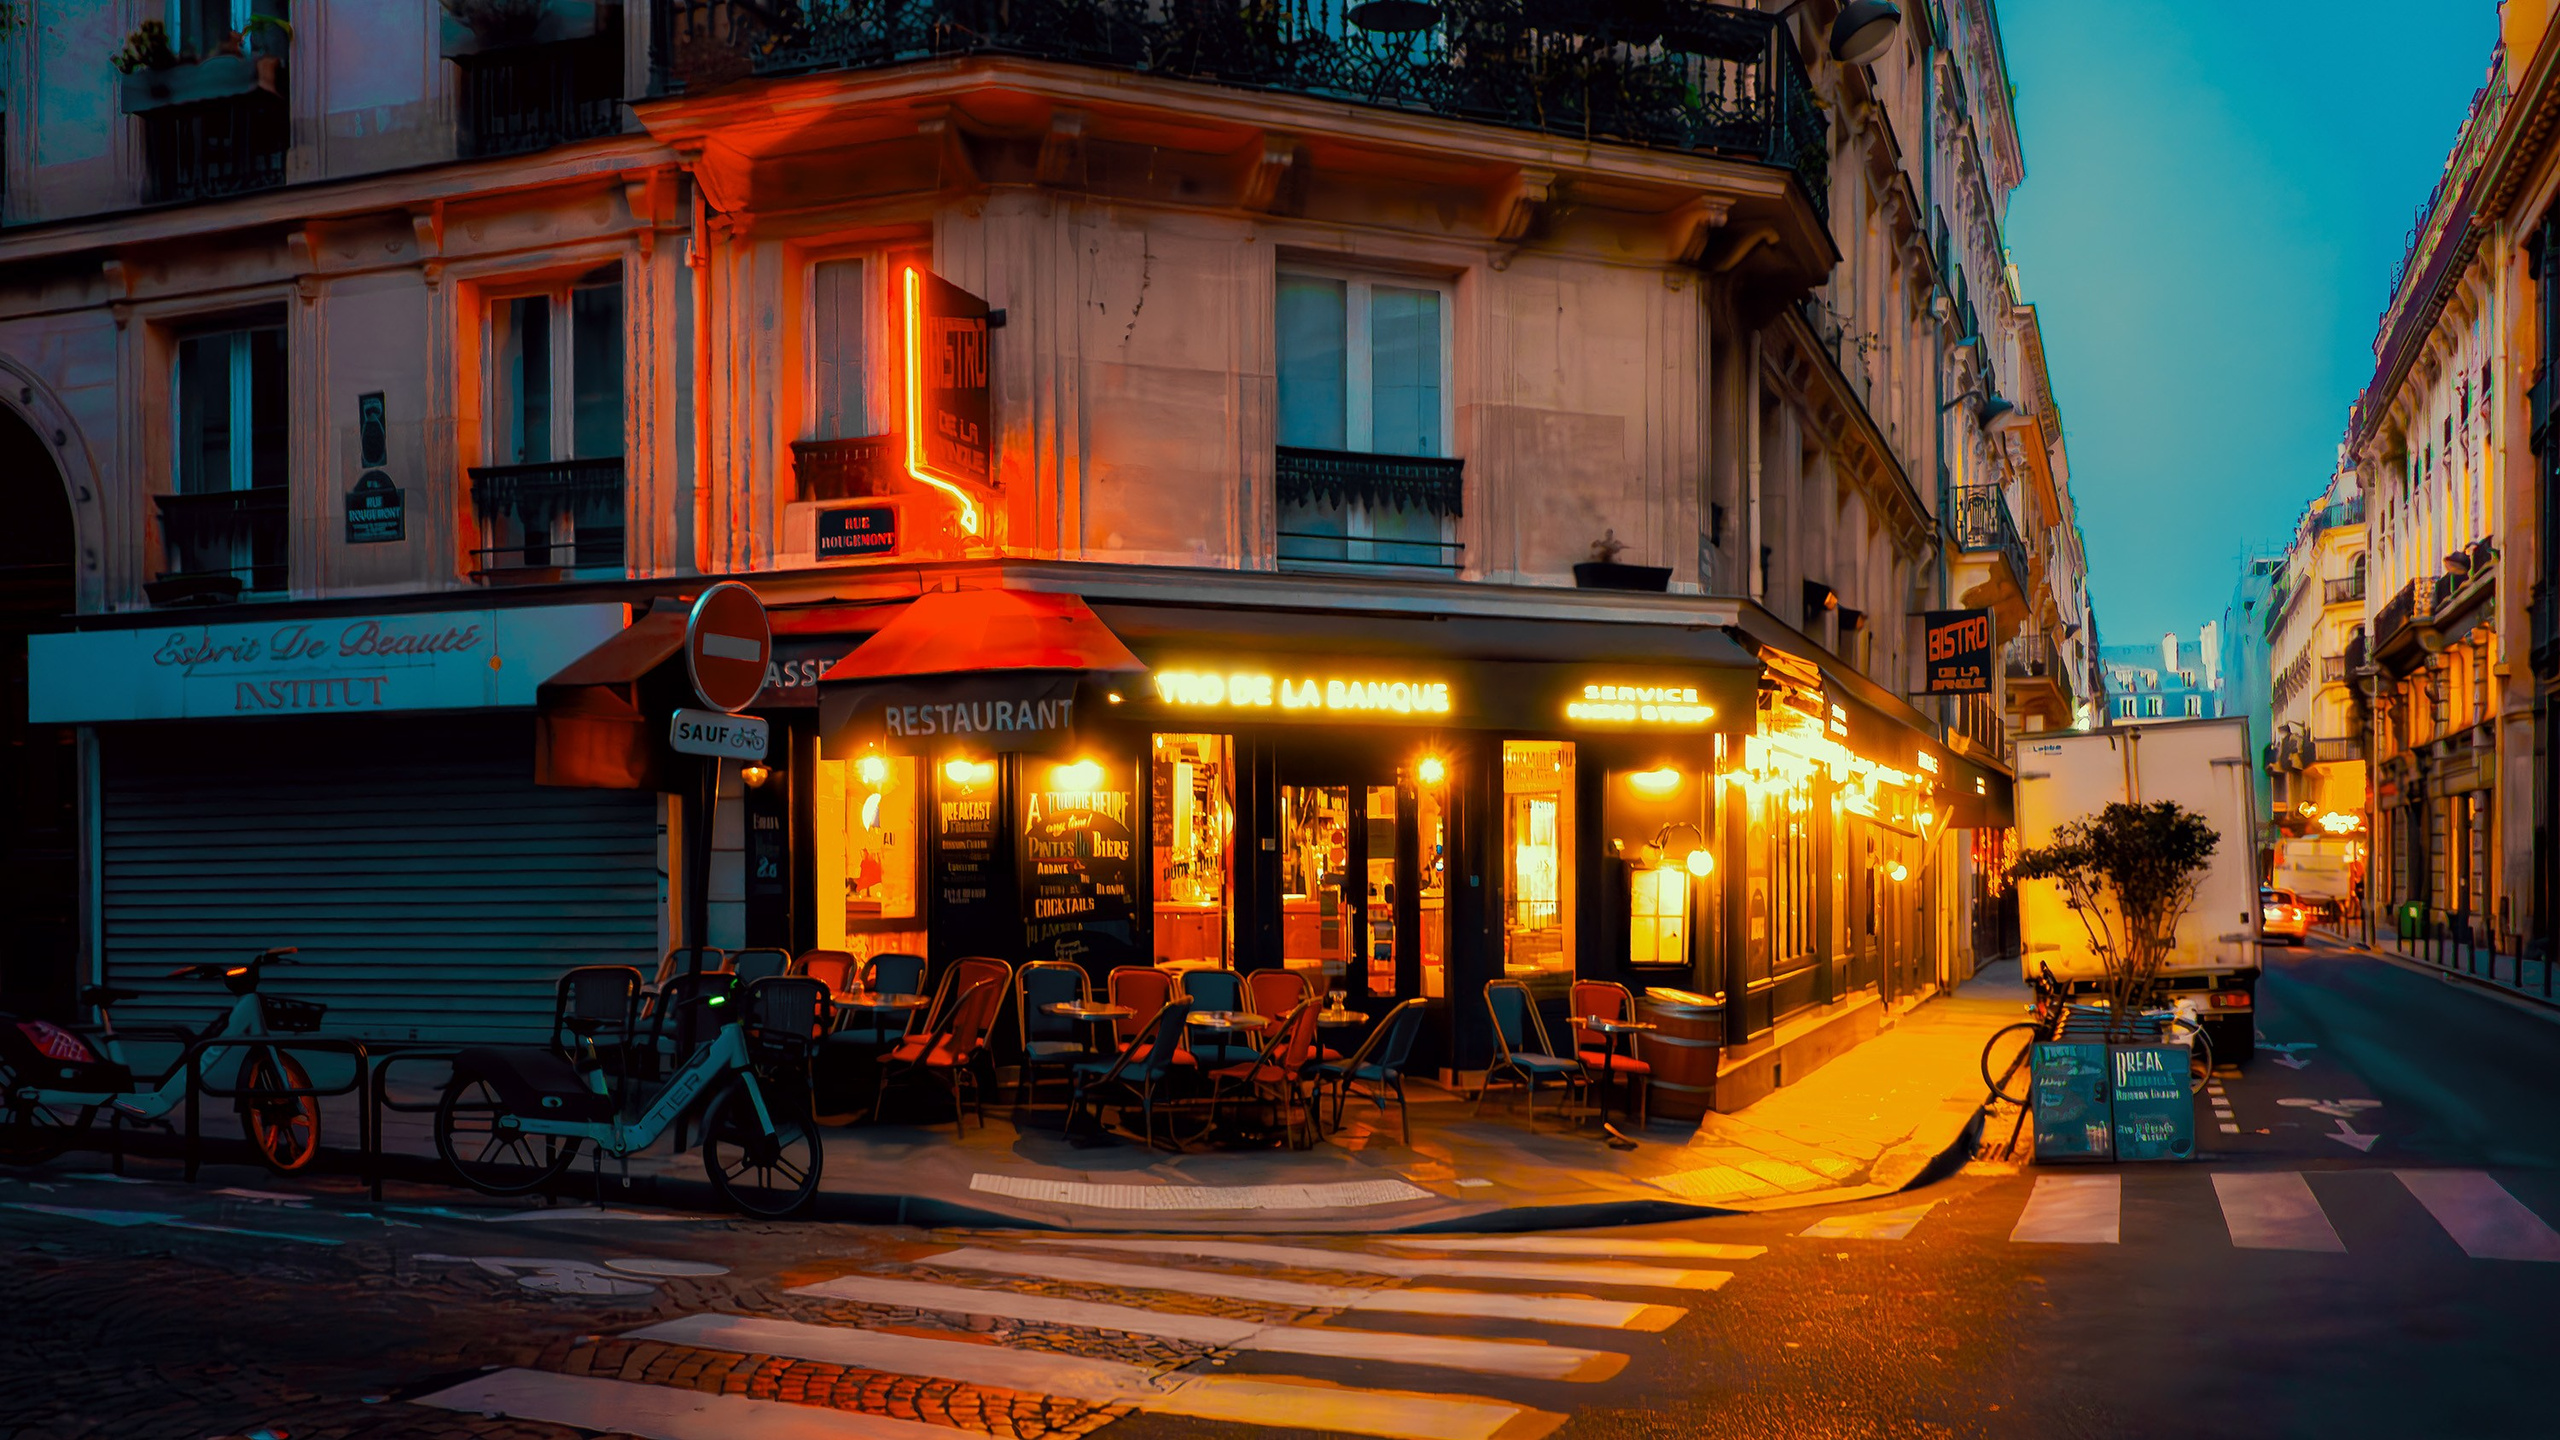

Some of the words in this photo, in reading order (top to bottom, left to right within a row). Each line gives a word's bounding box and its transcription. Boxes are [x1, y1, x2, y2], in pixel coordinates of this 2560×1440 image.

[821, 532, 895, 549] ROUGEMONT
[844, 516, 870, 530] RUE
[152, 631, 260, 677] Esprit
[270, 625, 330, 661] De
[1928, 616, 1988, 662] BISTRO
[234, 675, 389, 711] INSTITUT
[1228, 675, 1272, 705] DE
[1281, 678, 1320, 708] LA
[1327, 680, 1449, 713] BANQUE
[1584, 685, 1699, 702] SERVICE
[679, 721, 729, 744] SAUF
[886, 699, 1073, 736] RESTAURANT
[941, 801, 991, 834] BREAKFAST
[1024, 792, 1042, 836] A
[1035, 897, 1095, 918] COCKTAILS
[651, 1072, 699, 1121] TIER
